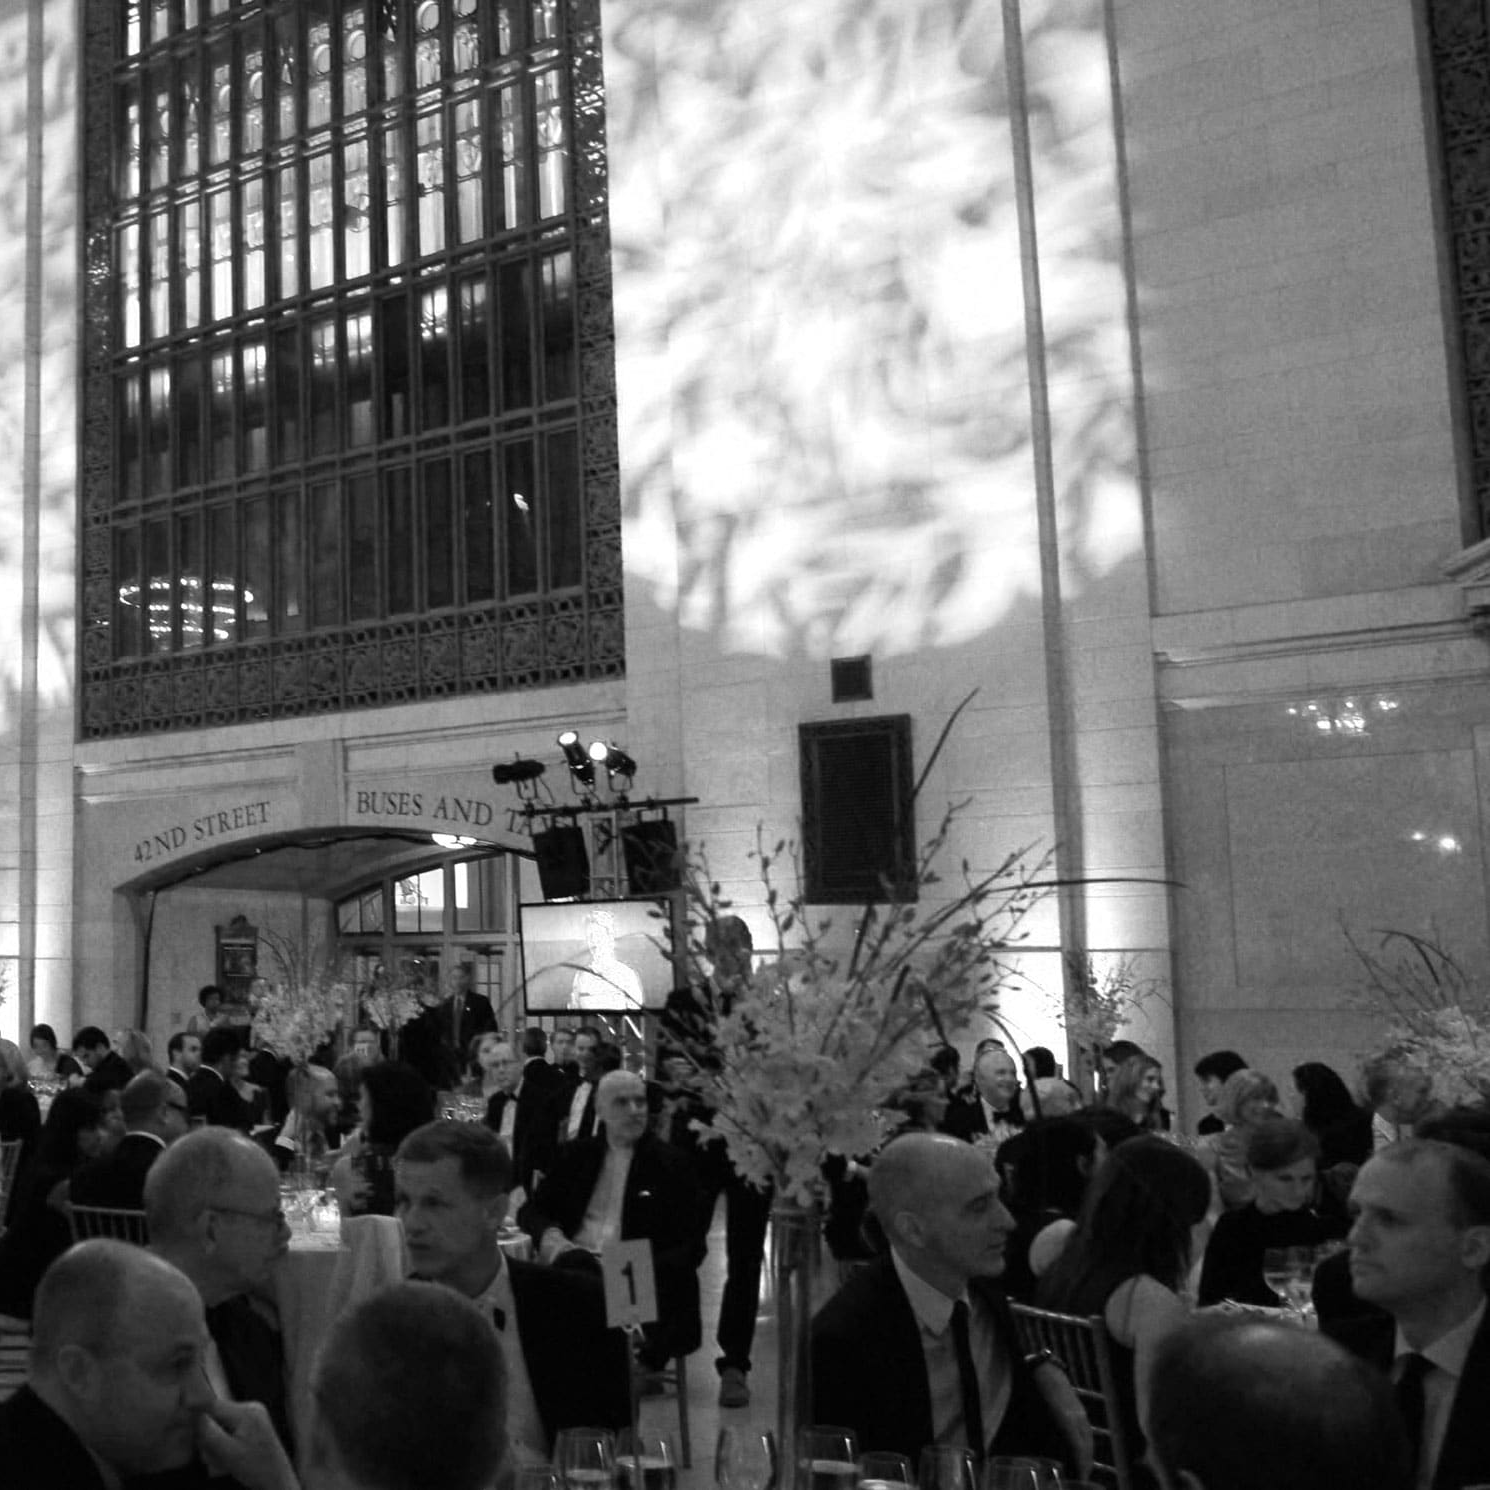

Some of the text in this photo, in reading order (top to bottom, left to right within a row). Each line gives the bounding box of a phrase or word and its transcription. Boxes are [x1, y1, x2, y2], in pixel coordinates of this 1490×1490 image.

[357, 791, 423, 817] BUSES
[432, 796, 494, 826] AND
[134, 801, 270, 863] 42ND STREET
[621, 1260, 637, 1306] 1
